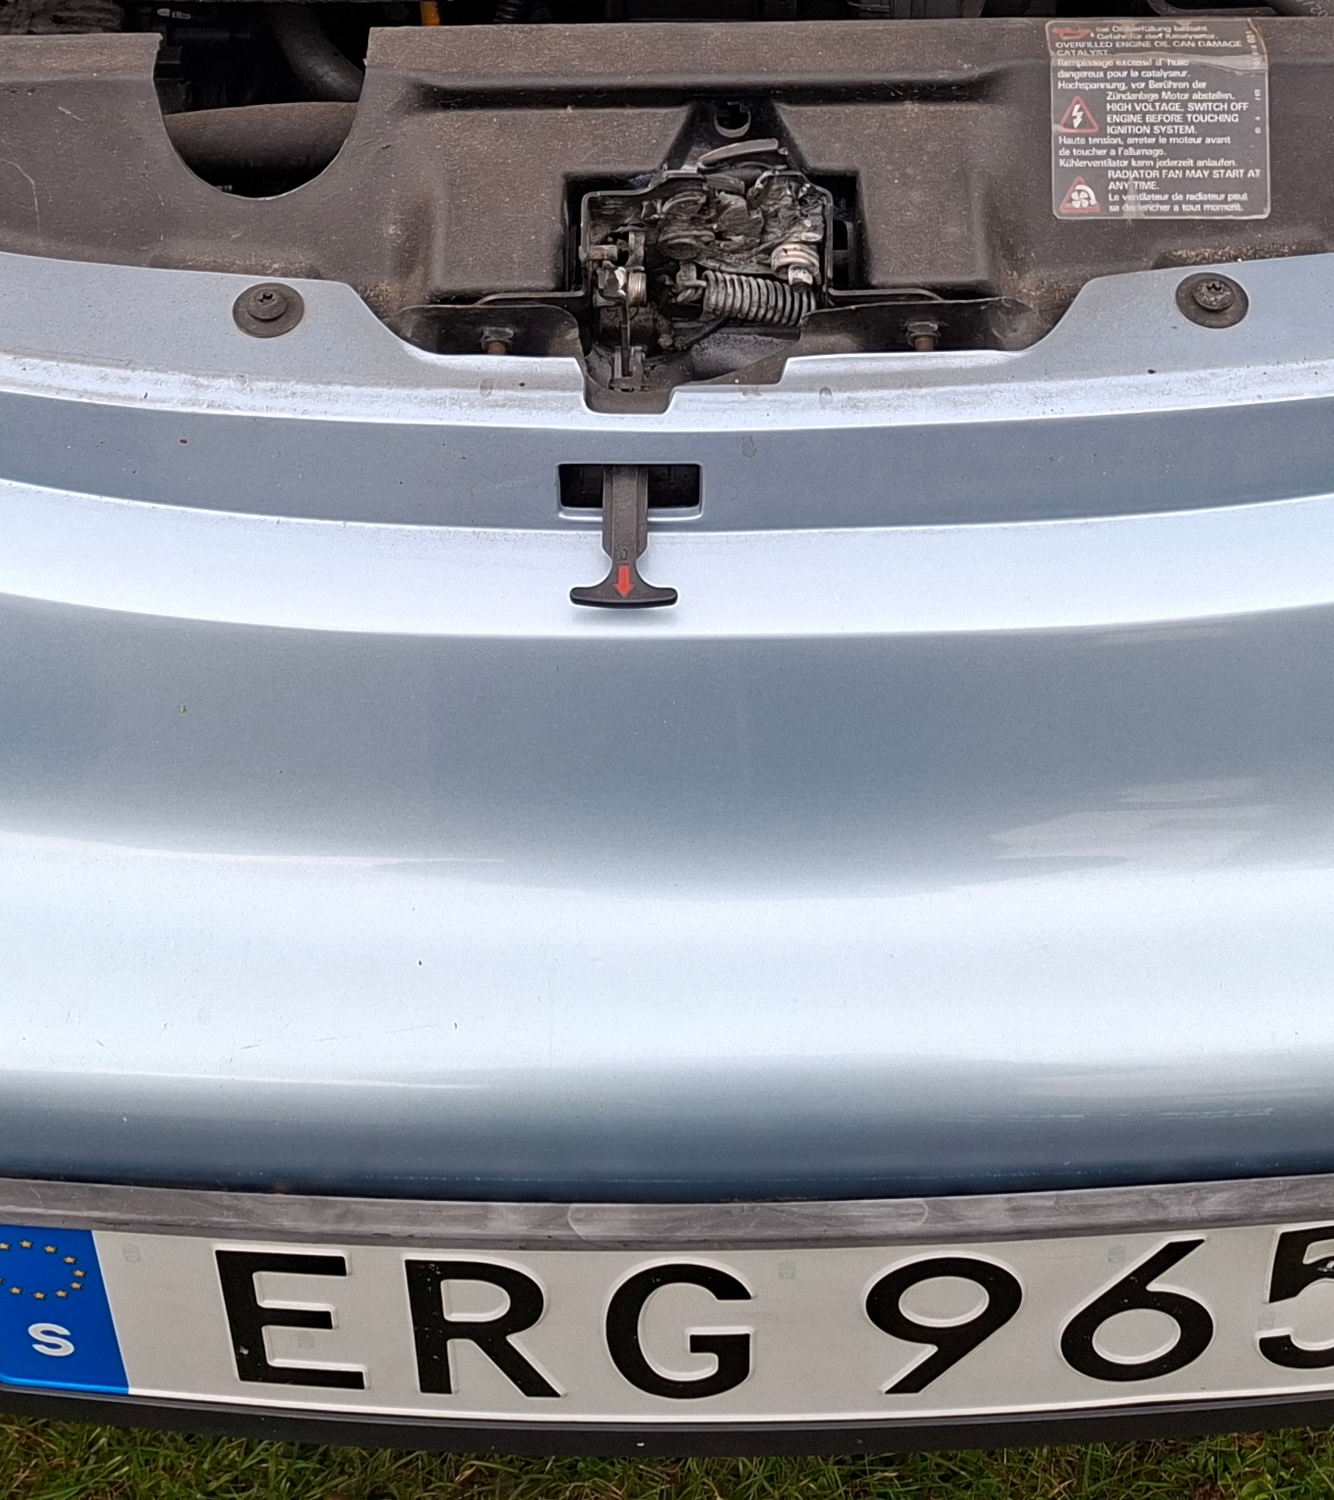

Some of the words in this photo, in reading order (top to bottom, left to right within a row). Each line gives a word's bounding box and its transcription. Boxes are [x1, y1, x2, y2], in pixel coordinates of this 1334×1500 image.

[1058, 70, 1104, 80] dangereux
[1107, 71, 1128, 80] pour
[1130, 69, 1139, 78] le
[1141, 68, 1190, 78] catalyseur.
[1149, 80, 1189, 88] Berühren
[1192, 80, 1207, 88] der
[1161, 91, 1189, 100] Motor
[1107, 103, 1131, 111] HIGH
[1187, 102, 1227, 111] SWITCH
[1230, 102, 1249, 111] OFF
[1107, 114, 1143, 122] ENGINE
[1145, 114, 1183, 122] BEFORE
[1186, 114, 1239, 122] TOUCHING
[1107, 125, 1150, 134] IGNITION
[1153, 125, 1198, 134] SYSTEM.
[1058, 136, 1085, 144] Haute
[1159, 136, 1167, 144] le
[1170, 136, 1202, 144] moteur
[1205, 136, 1231, 144] avant
[1059, 147, 1070, 156] de
[1073, 147, 1107, 156] toucher
[1059, 158, 1129, 168] Kühlerventilator
[1131, 158, 1153, 167] kann
[1156, 158, 1194, 168] jederzeit
[1196, 158, 1237, 167] anlaufen.
[1108, 170, 1159, 178] RADIATOR
[1162, 170, 1183, 178] FAN
[1185, 170, 1209, 178] MAY
[1213, 169, 1244, 178] START
[1247, 169, 1261, 178] AT
[1109, 182, 1130, 190] ANY
[1133, 181, 1159, 190] TIME.
[1109, 192, 1119, 201] Le
[1172, 192, 1183, 200] de
[1186, 192, 1225, 200] radiateur
[1228, 192, 1248, 202] peut
[1182, 204, 1201, 212] tout
[215, 1249, 753, 1398] ERG
[28, 1323, 74, 1356] S
